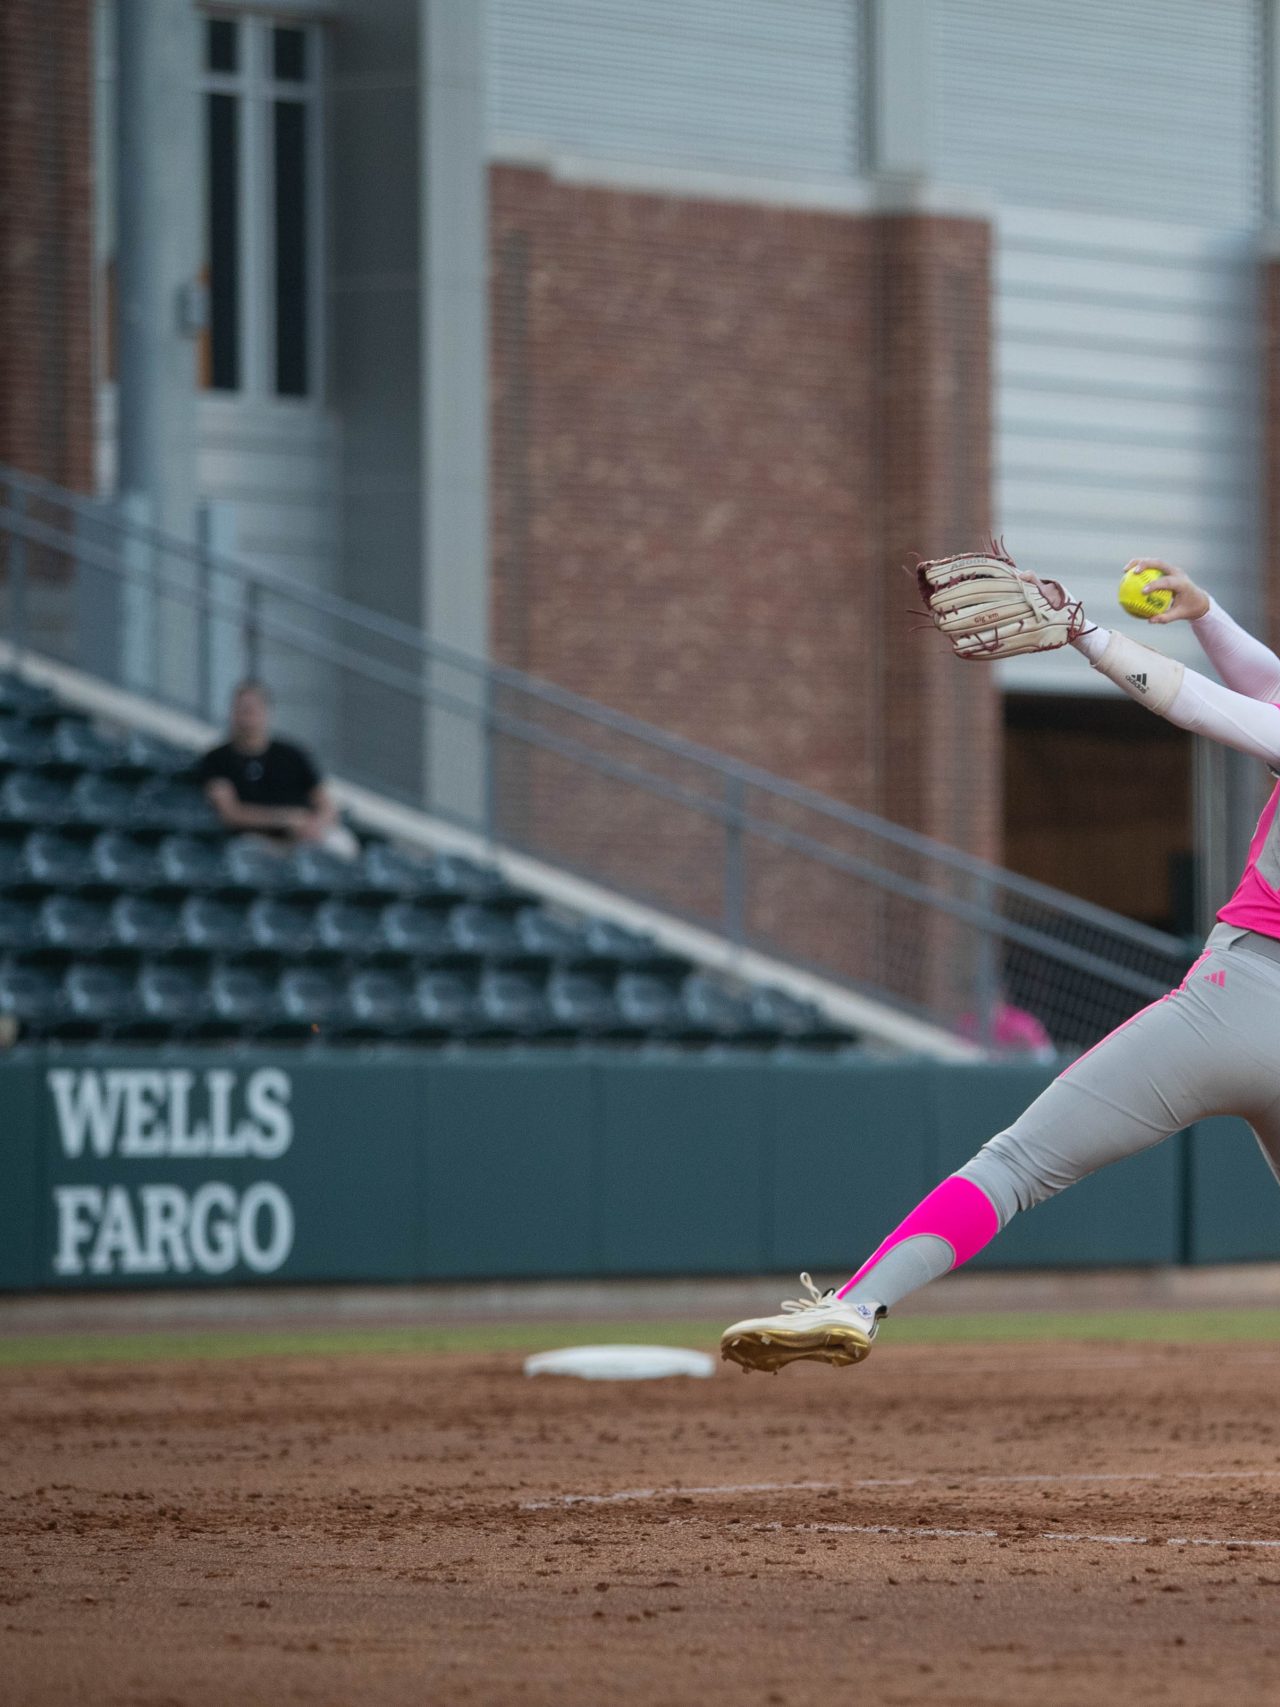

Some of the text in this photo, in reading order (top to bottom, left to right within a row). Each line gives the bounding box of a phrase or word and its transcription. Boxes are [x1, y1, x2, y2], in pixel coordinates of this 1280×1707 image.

[1124, 674, 1148, 694] adidas
[48, 1067, 294, 1160] WELLS
[52, 1180, 295, 1276] FARGO
